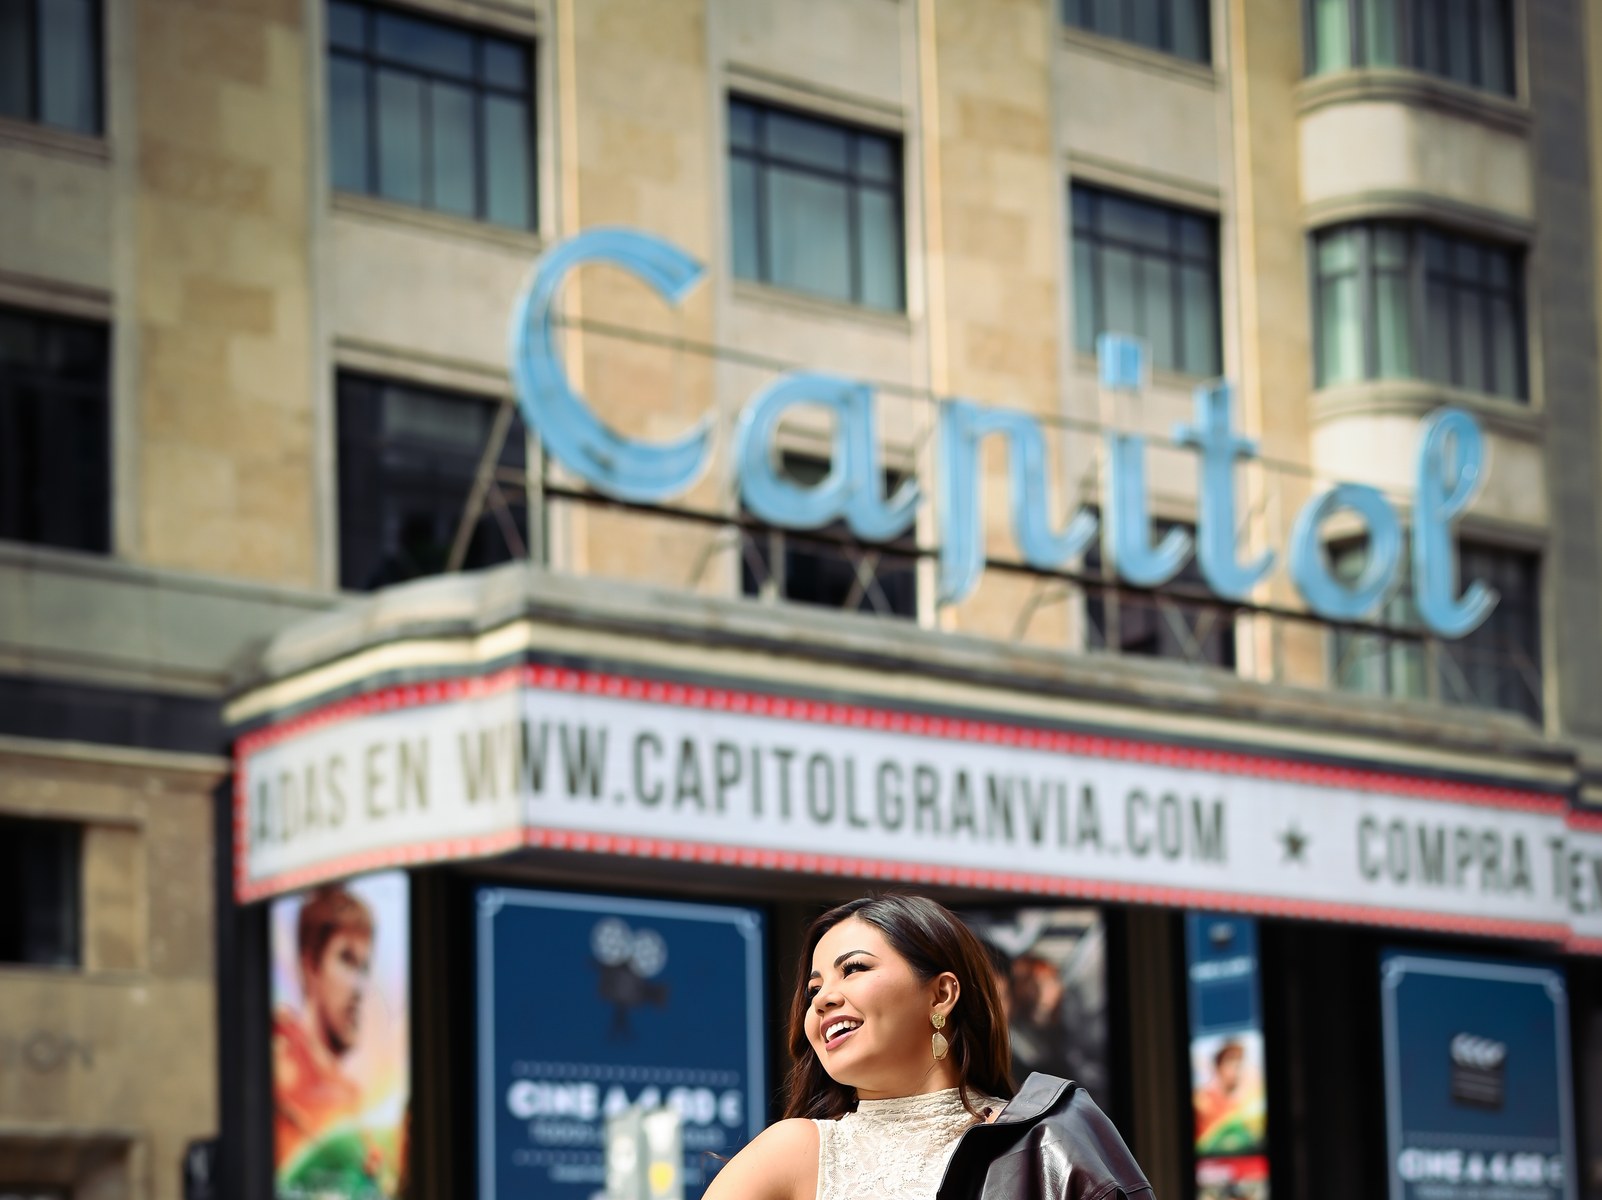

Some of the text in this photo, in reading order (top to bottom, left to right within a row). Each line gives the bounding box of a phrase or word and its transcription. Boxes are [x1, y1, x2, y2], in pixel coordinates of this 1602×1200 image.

[509, 224, 1499, 638] Capitol
[364, 736, 430, 822] EN
[1357, 814, 1534, 898] COMPRA
